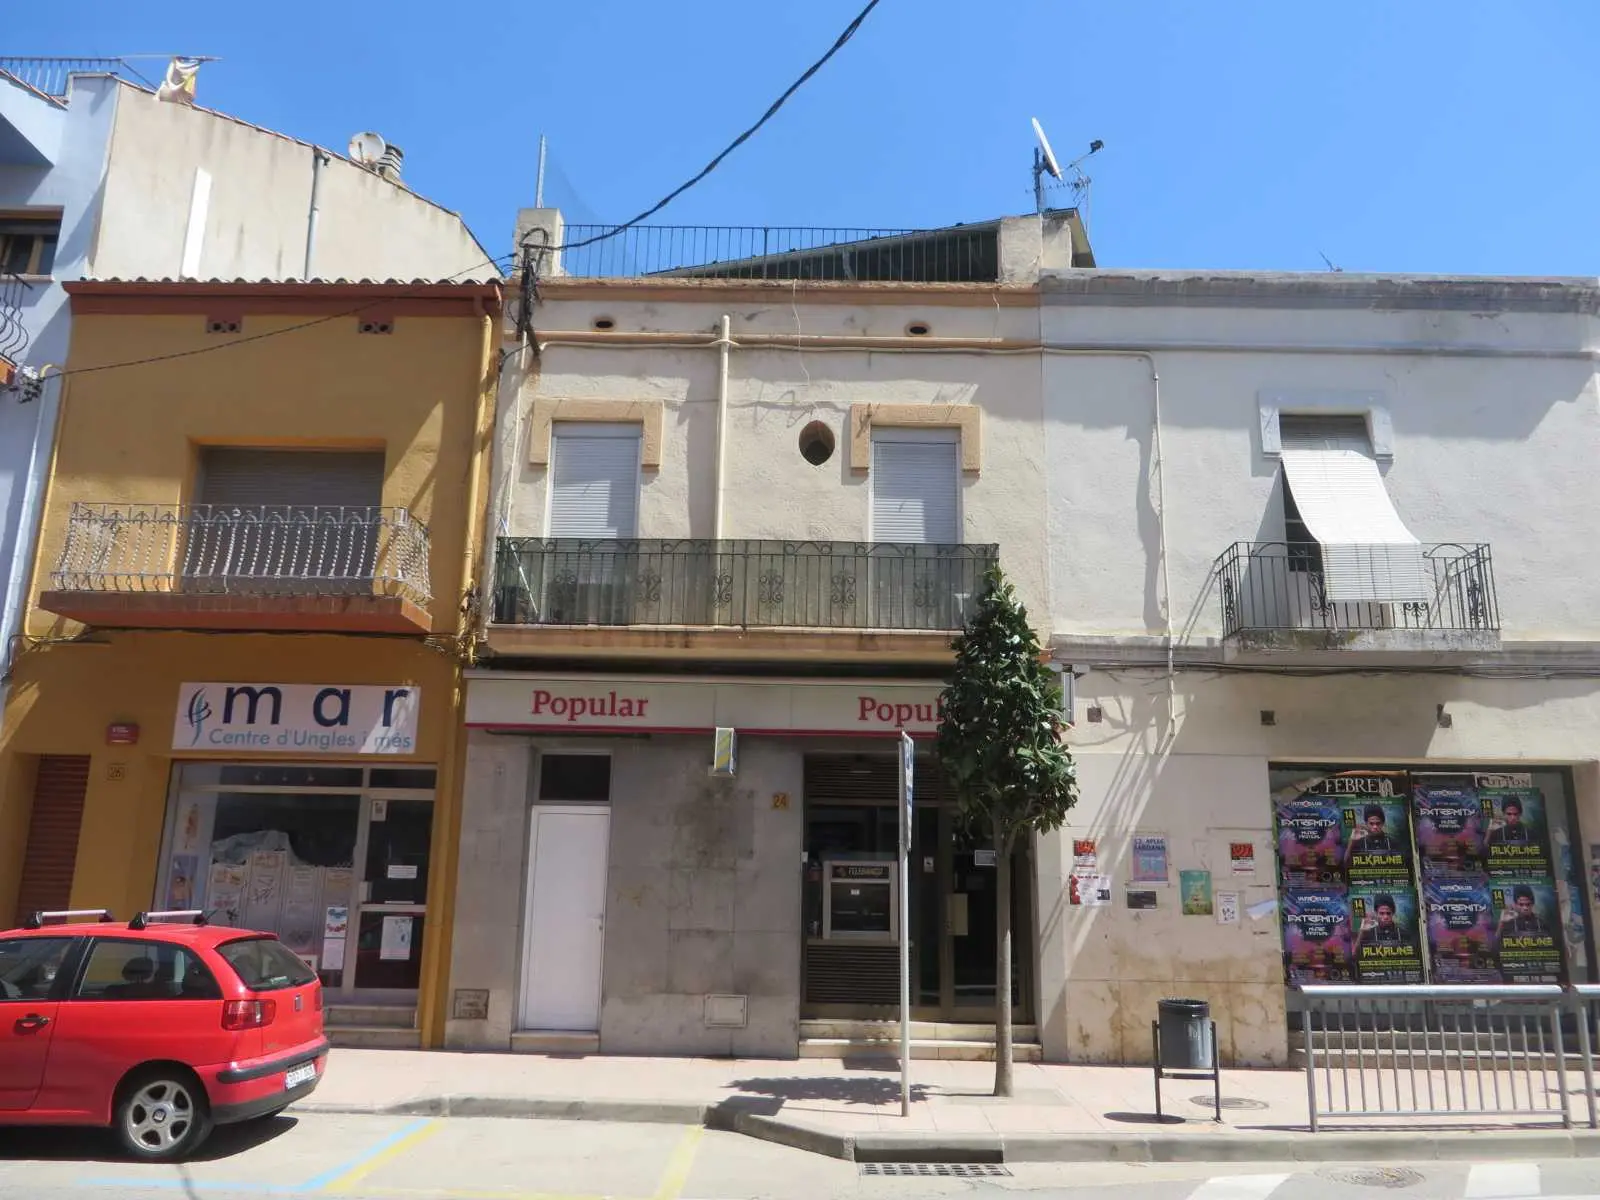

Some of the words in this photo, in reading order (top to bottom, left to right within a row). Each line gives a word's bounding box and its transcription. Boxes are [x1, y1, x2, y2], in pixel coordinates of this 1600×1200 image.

[222, 686, 411, 727] mar
[531, 690, 649, 721] Popular
[857, 697, 945, 727] Popul
[209, 728, 270, 746] Centre
[277, 729, 355, 749] d'Ungles
[1325, 778, 1381, 793] FEBRE
[1420, 808, 1476, 817] EXTREMITY
[1281, 819, 1336, 827] EXTREMITY
[1491, 843, 1541, 856] ALKALINE
[1352, 854, 1403, 865] ALKALINE
[1430, 903, 1487, 912] EXTREMITY
[1287, 914, 1344, 923] EXTREMITY
[1503, 936, 1553, 948] ALKALINE
[1362, 944, 1414, 957] ALKALINE
